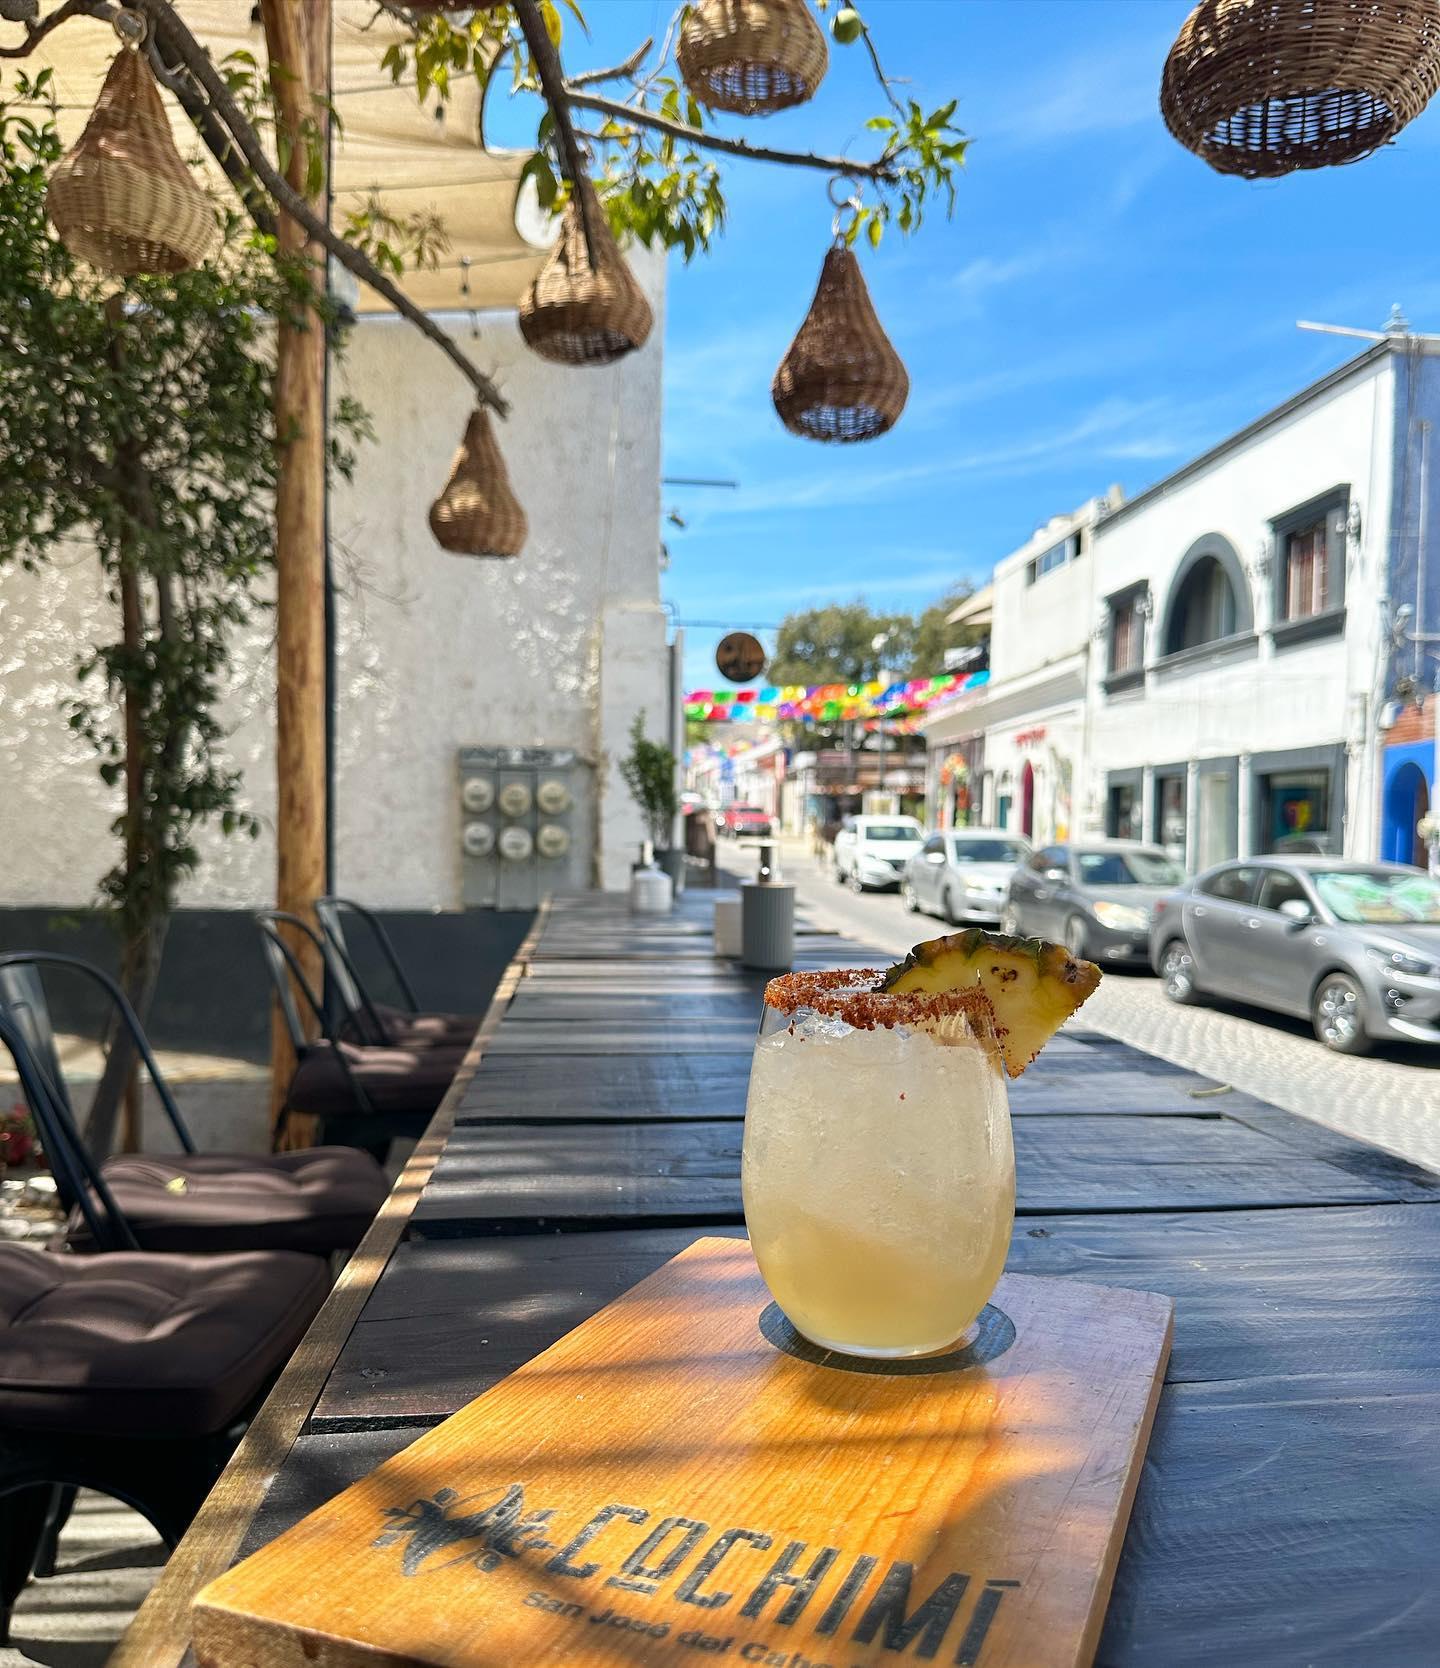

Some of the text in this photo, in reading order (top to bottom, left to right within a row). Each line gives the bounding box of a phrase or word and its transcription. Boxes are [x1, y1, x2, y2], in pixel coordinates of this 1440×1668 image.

[523, 1590, 585, 1618] San
[589, 1608, 672, 1639] José
[676, 1630, 736, 1654] del
